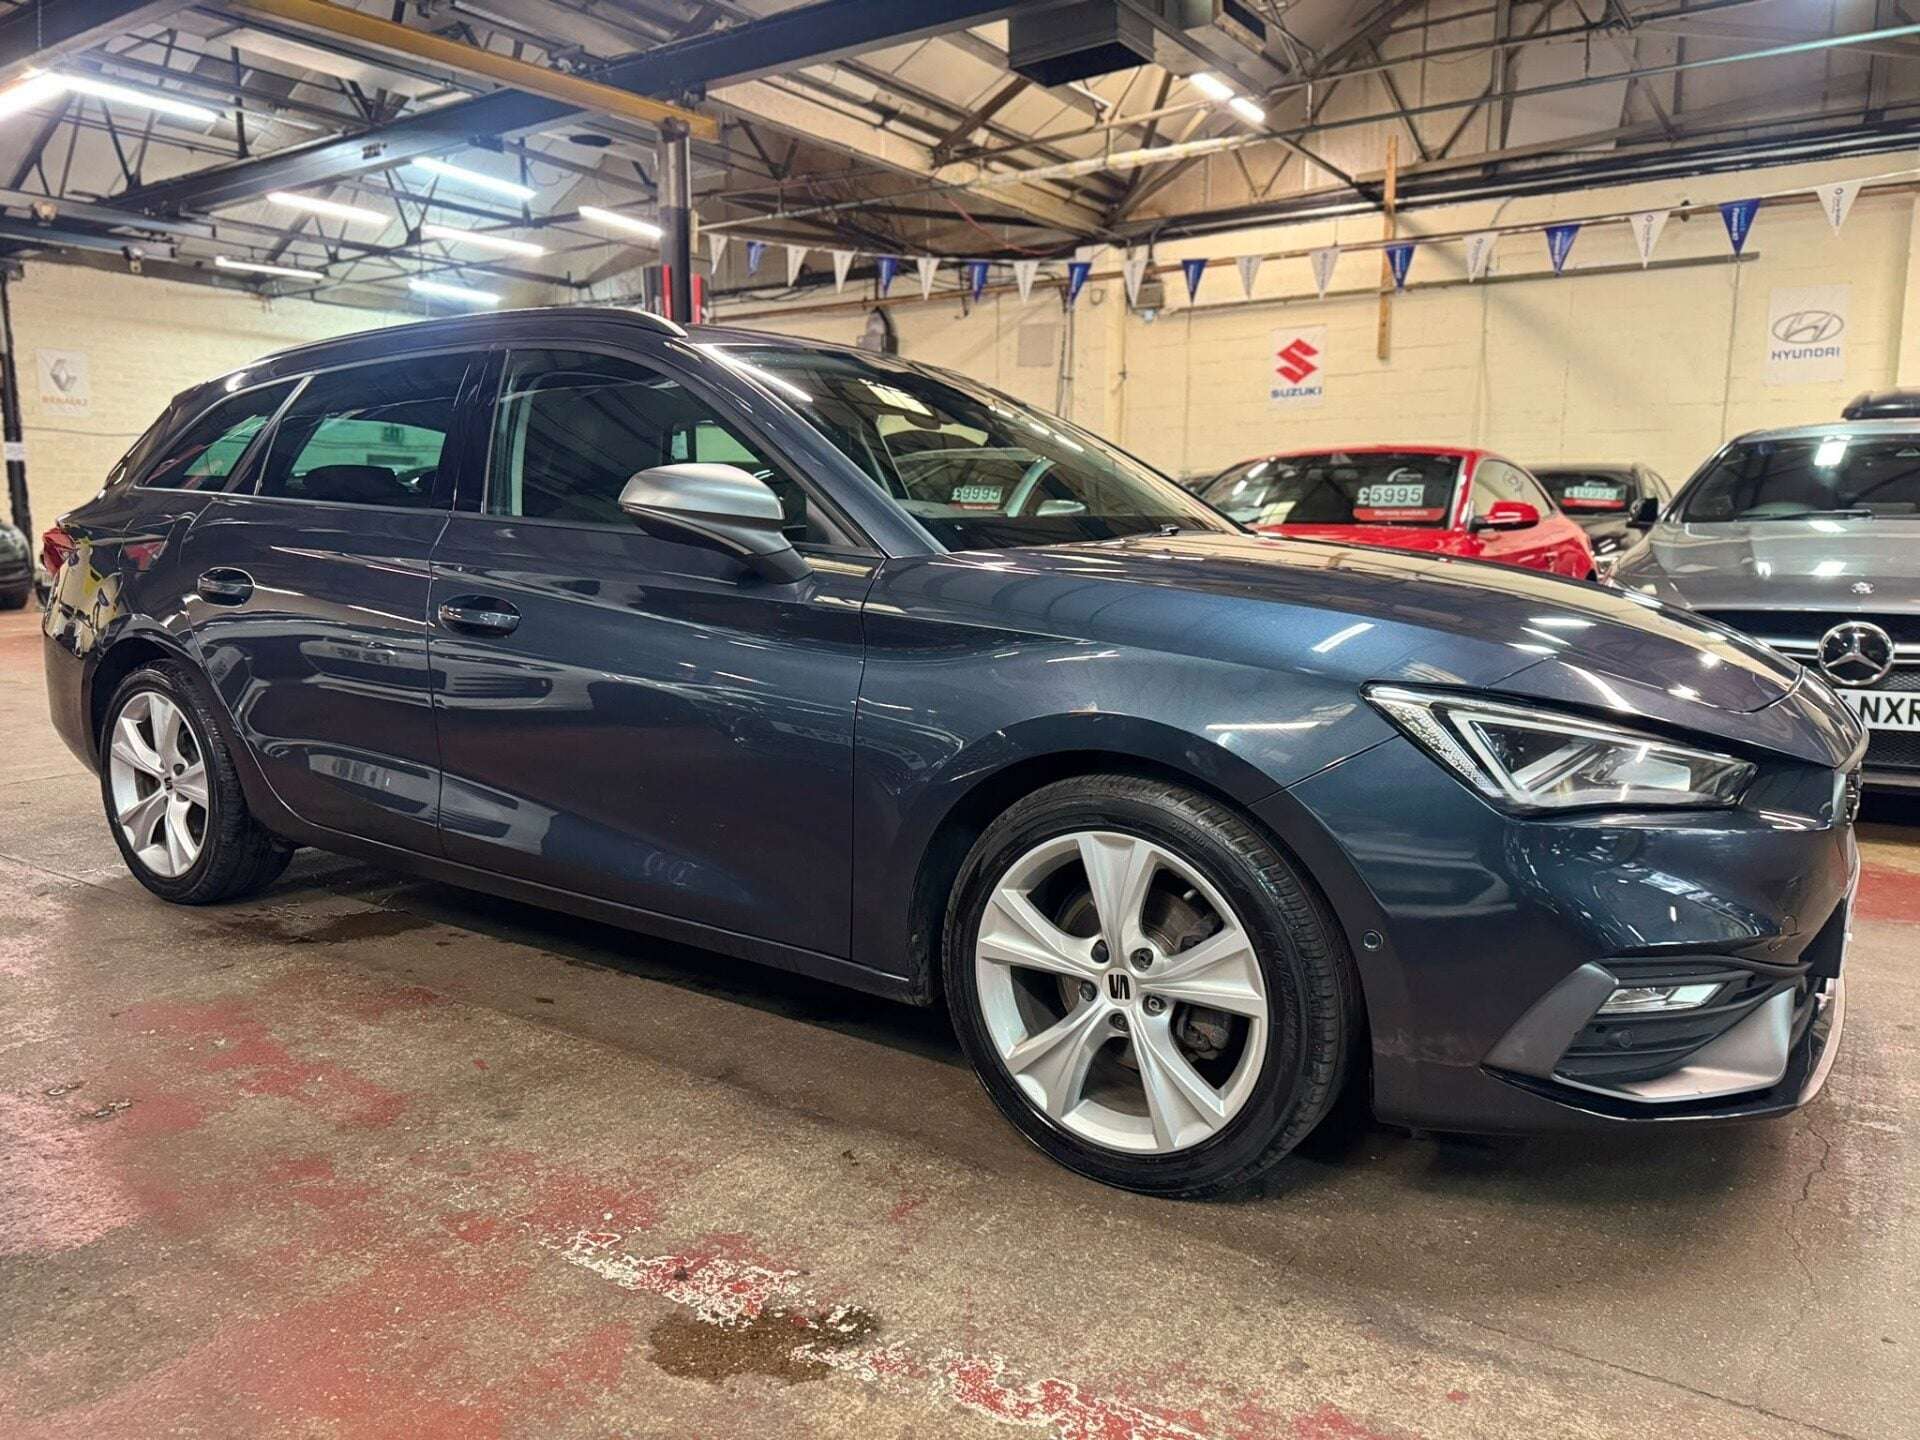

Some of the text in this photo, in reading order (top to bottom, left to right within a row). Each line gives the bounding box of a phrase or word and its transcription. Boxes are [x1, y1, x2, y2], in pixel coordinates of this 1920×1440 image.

[1772, 347, 1840, 360] HYUNDAI
[1270, 387, 1323, 399] SUZUKI
[1357, 486, 1423, 505] £5995
